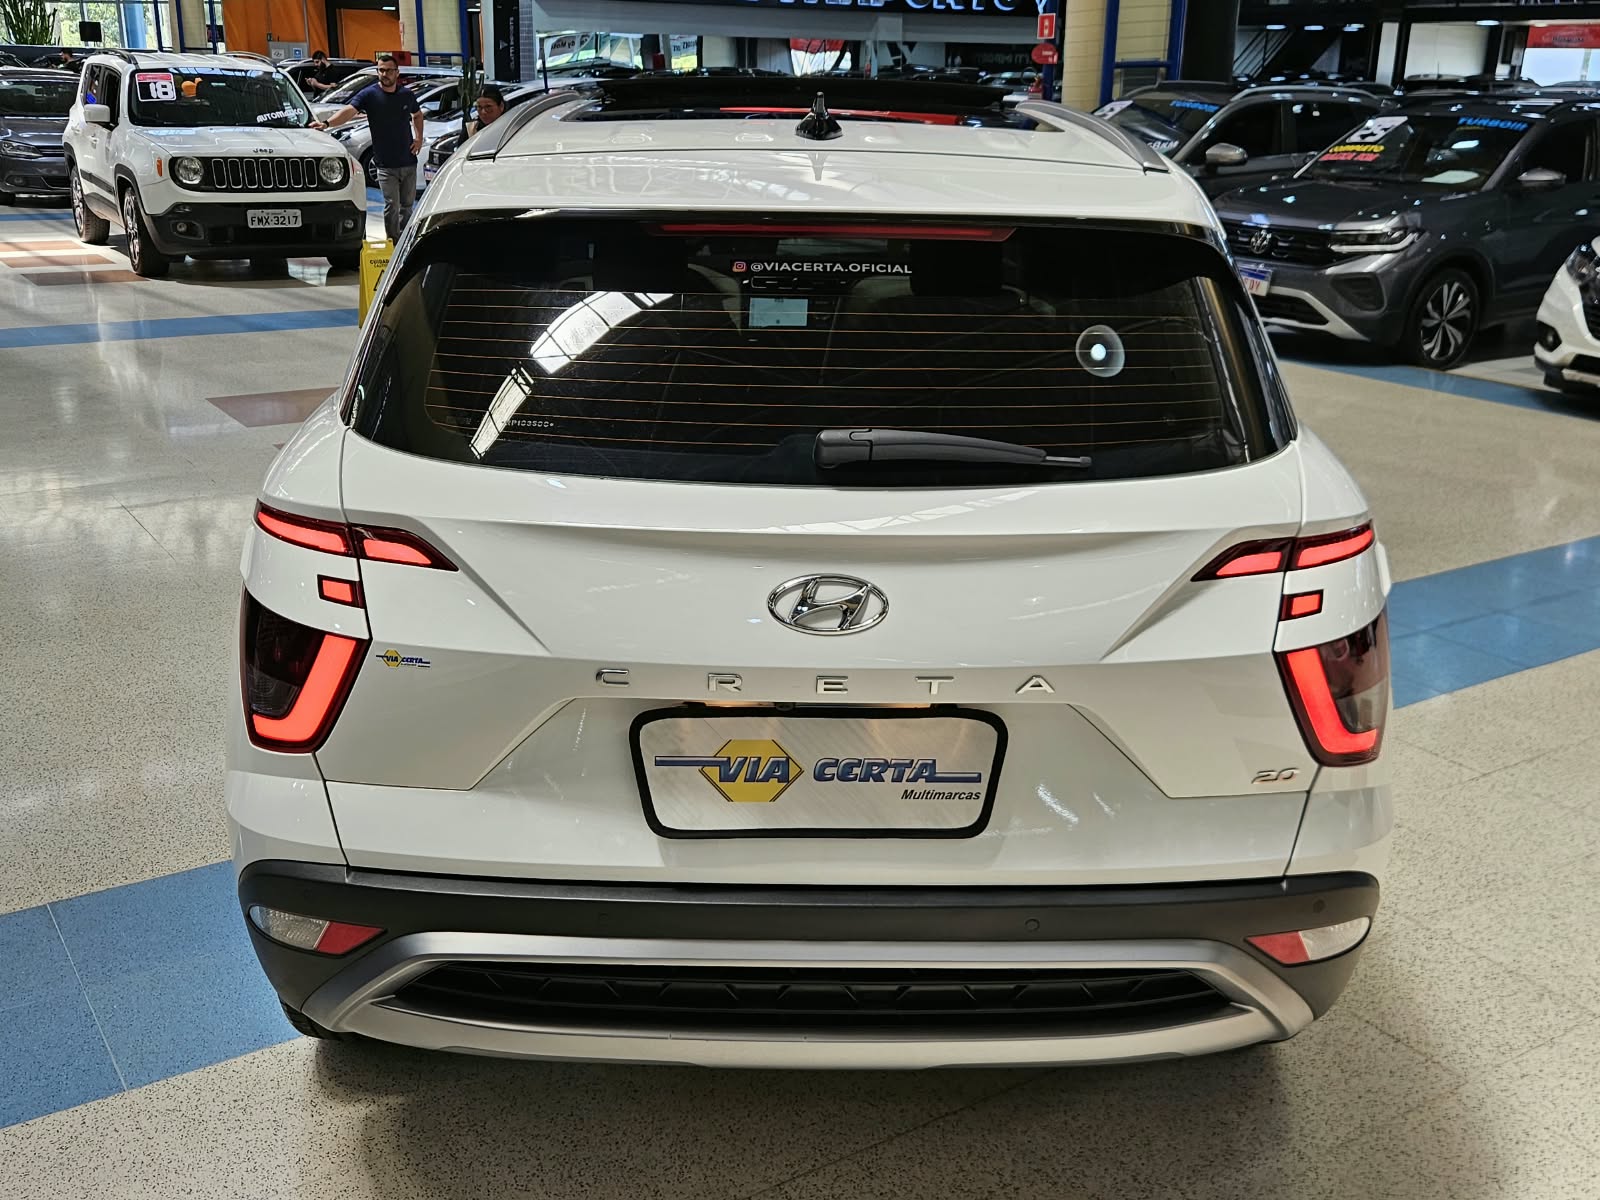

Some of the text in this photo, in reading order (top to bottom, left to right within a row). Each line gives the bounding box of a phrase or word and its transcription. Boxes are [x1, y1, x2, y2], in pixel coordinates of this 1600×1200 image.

[149, 81, 174, 99] 18
[750, 262, 912, 274] @VIACERTA.OFICIAL
[595, 668, 1056, 694] CRETA
[718, 756, 937, 783] VIA CERTA
[900, 789, 982, 801] Multimarcas
